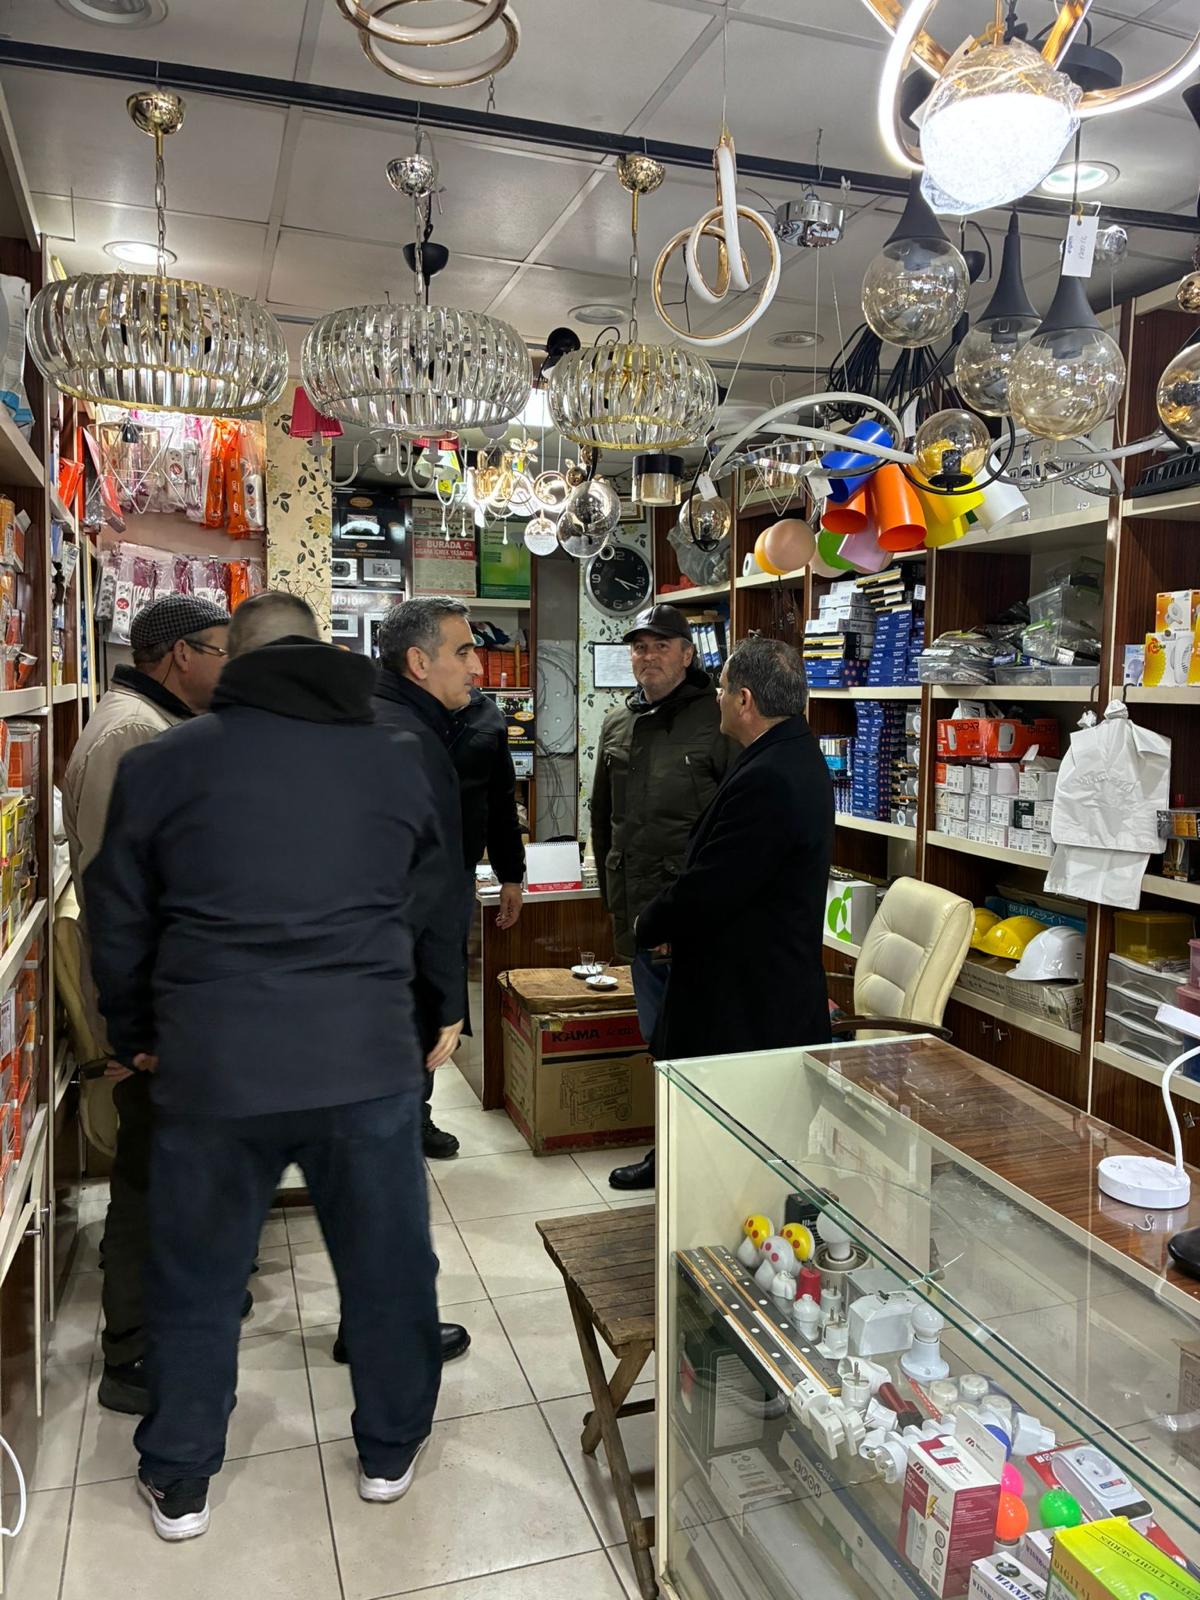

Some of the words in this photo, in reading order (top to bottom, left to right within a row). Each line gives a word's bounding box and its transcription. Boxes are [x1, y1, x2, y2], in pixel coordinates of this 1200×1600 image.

[426, 541, 461, 549] BURADA
[591, 573, 601, 583] 9
[613, 600, 623, 609] 6
[552, 1029, 600, 1042] KAMA
